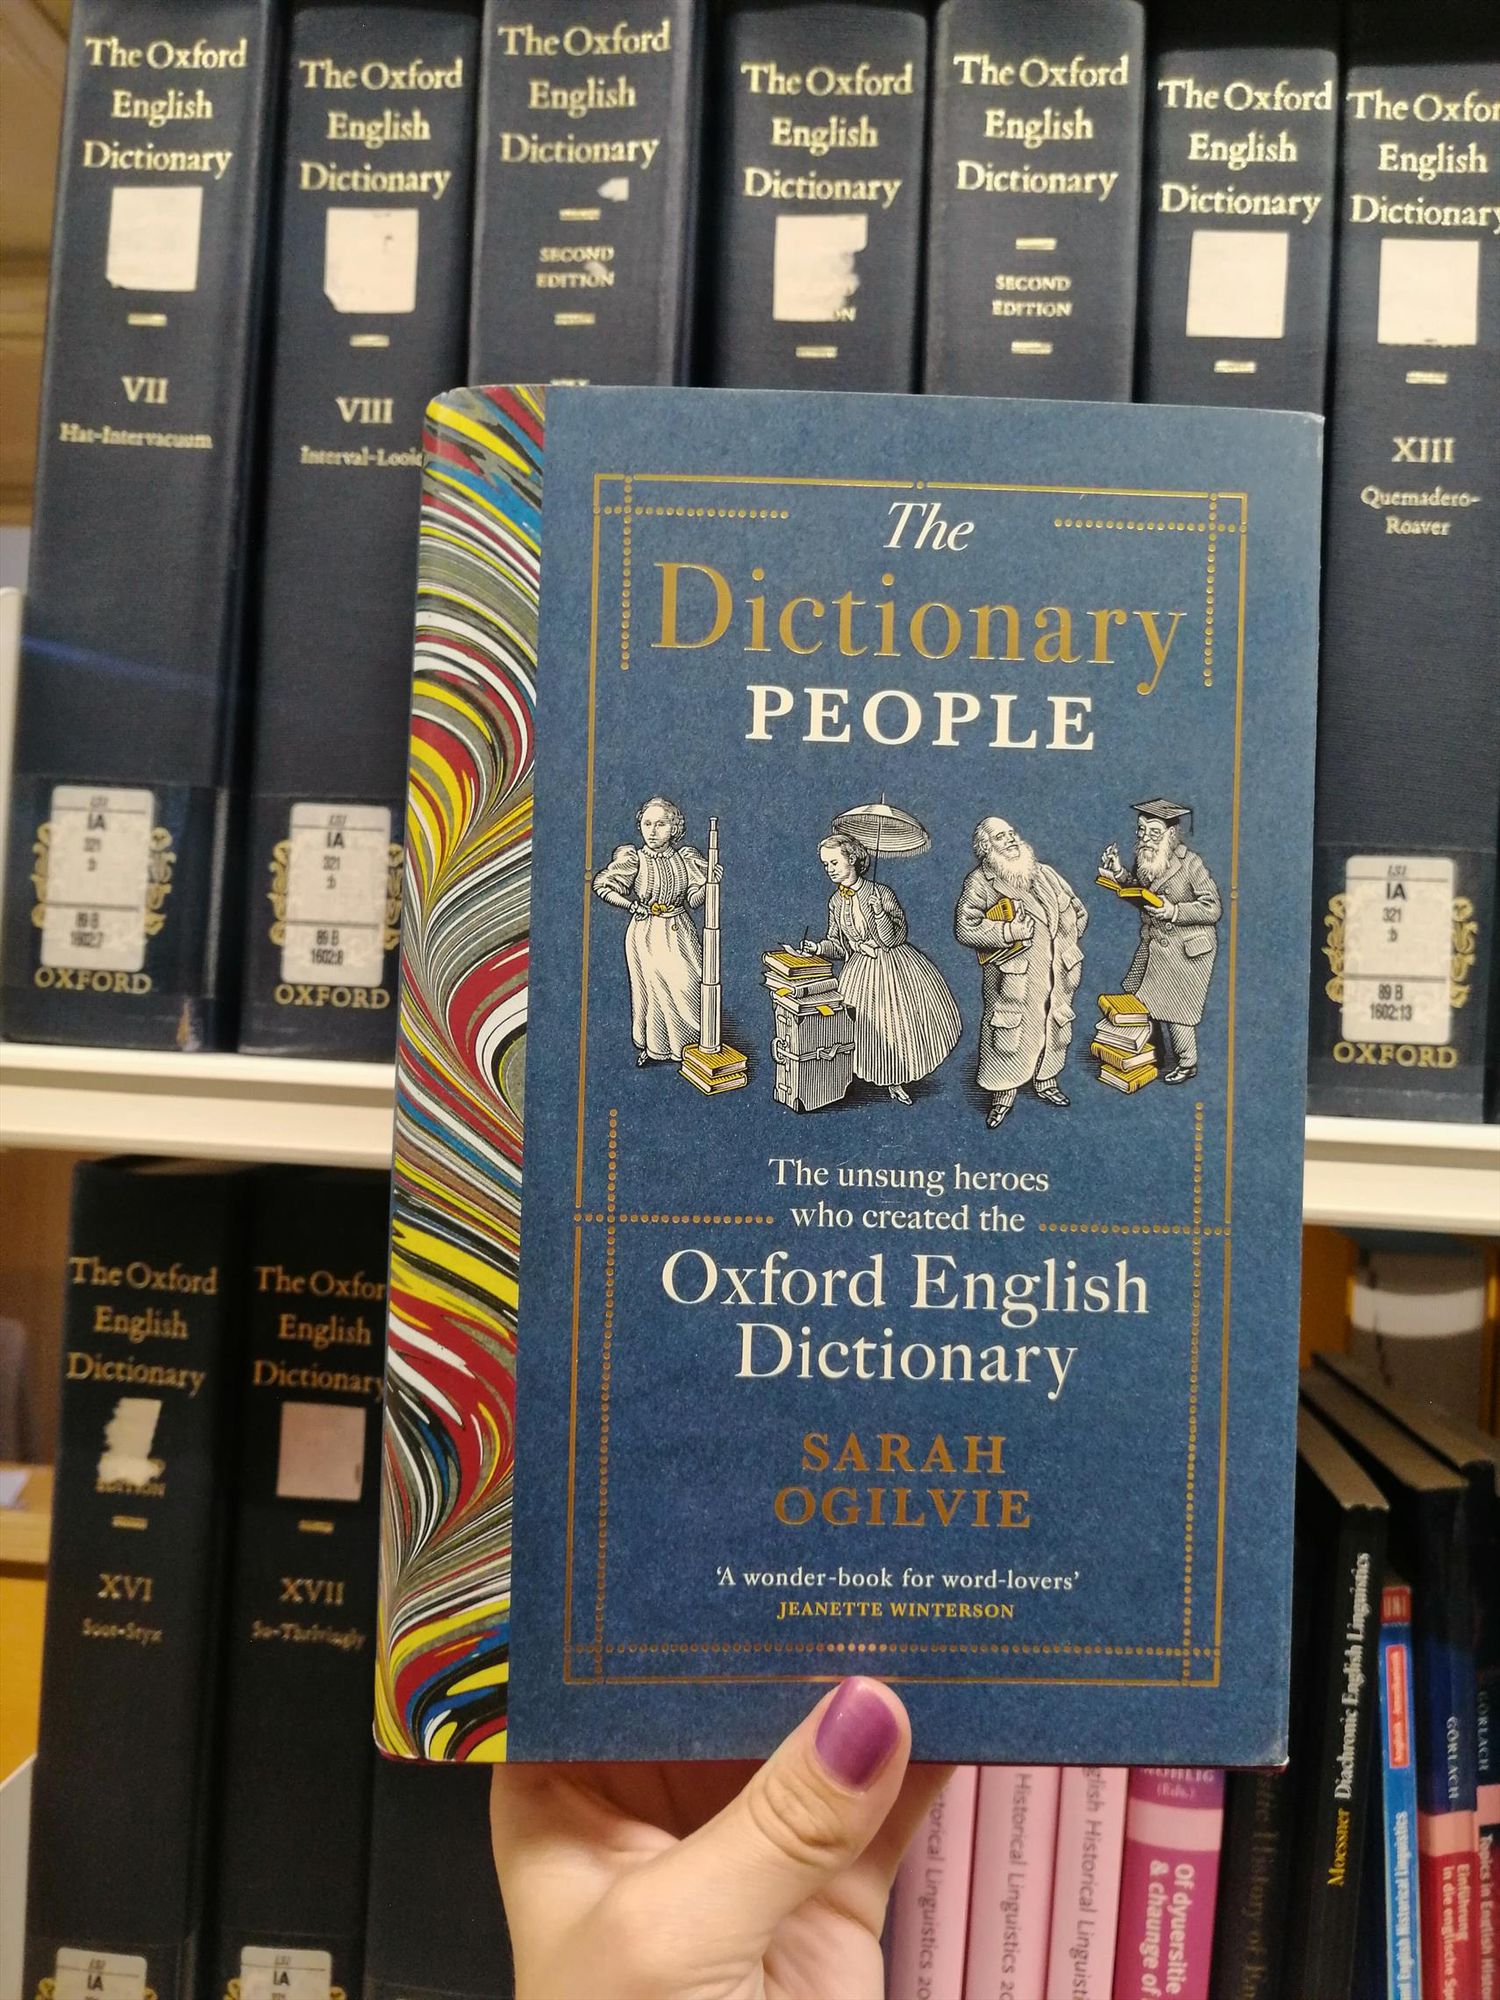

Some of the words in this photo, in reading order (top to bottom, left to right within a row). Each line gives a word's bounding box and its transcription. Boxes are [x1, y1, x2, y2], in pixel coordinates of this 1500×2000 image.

[84, 36, 143, 68] The
[146, 38, 248, 69] Oxford
[499, 26, 558, 57] The
[562, 20, 671, 56] Oxford
[300, 58, 358, 90] The
[361, 57, 463, 91] Oxford
[741, 62, 801, 95] The
[806, 62, 914, 97] Oxford
[953, 54, 1014, 86] The
[1018, 53, 1130, 89] Oxford
[111, 88, 214, 128] English
[528, 76, 637, 119] English
[1157, 78, 1219, 109] The
[1223, 79, 1333, 111] Oxford
[1346, 88, 1408, 121] The
[327, 109, 431, 150] English
[771, 115, 879, 157] English
[984, 106, 1094, 149] English
[83, 139, 233, 180] Dictionary
[501, 132, 660, 170] Dictionary
[1188, 129, 1298, 171] English
[1377, 142, 1489, 182] English
[300, 161, 452, 200] Dictionary
[744, 166, 902, 209] Dictionary
[956, 159, 1119, 202] Dictionary
[1159, 183, 1322, 224] Dictionary
[539, 245, 615, 263] SECOND
[536, 271, 615, 288] EDITION
[995, 273, 1072, 291] SECOND
[992, 299, 1072, 317] EDITION
[121, 376, 168, 404] VII
[335, 396, 394, 424] VIII
[1392, 437, 1455, 463] XIII
[882, 502, 976, 553] The
[1386, 515, 1451, 536] Roaver
[650, 561, 1187, 695] Dictionary
[745, 684, 1095, 751] PEOPLE
[327, 832, 345, 849] IA
[1386, 883, 1406, 900] IA
[34, 966, 152, 994] OXFORD
[273, 983, 391, 1010] OXFORD
[1394, 985, 1404, 1001] B
[1332, 1040, 1458, 1069] OXFORD
[769, 1157, 829, 1187] The
[837, 1165, 945, 1197] unsung
[953, 1163, 1049, 1193] heroes
[791, 1201, 854, 1229] who
[861, 1204, 970, 1231] created
[978, 1205, 1026, 1232] the
[69, 1256, 122, 1287] The
[126, 1261, 219, 1296] Oxford
[256, 1265, 306, 1292] The
[661, 1248, 886, 1307] Oxford
[910, 1253, 1150, 1329] English
[92, 1304, 189, 1345] English
[278, 1312, 373, 1350] English
[67, 1352, 206, 1397] Dictionary
[734, 1322, 1079, 1401] Dictionary
[802, 1432, 1006, 1474] SARAH
[774, 1486, 1031, 1528] OGILVIE
[98, 1573, 153, 1603] XVI
[280, 1577, 345, 1607] XVII
[743, 1567, 893, 1588] wonder-book
[901, 1567, 935, 1588] for
[1346, 1553, 1372, 1641] Linguistics
[777, 1601, 883, 1620] JEANETTE
[889, 1602, 1015, 1619] WINTERSON
[1342, 1645, 1366, 1705] English
[1335, 1709, 1359, 1799] Diachronic
[1010, 1772, 1033, 1866] Historical
[1077, 1819, 1103, 1913] Historical
[1150, 1859, 1169, 1875] &
[1327, 1808, 1350, 1887] Moessner
[1478, 1833, 1494, 1881] Topics
[1174, 1862, 1195, 1889] Of
[1442, 1866, 1455, 1880] in
[1480, 1882, 1493, 1897] in
[1442, 1883, 1456, 1906] die
[1457, 1863, 1471, 1941] Einführung
[917, 1867, 944, 1971] Linguistics
[1000, 1873, 1025, 1973] Linguistics
[1139, 1882, 1167, 1969] chaunge
[1480, 1900, 1494, 1954] English
[1165, 1891, 1193, 1995] dyuersitie
[1441, 1908, 1456, 1976] englische
[1141, 1973, 1163, 1997] of
